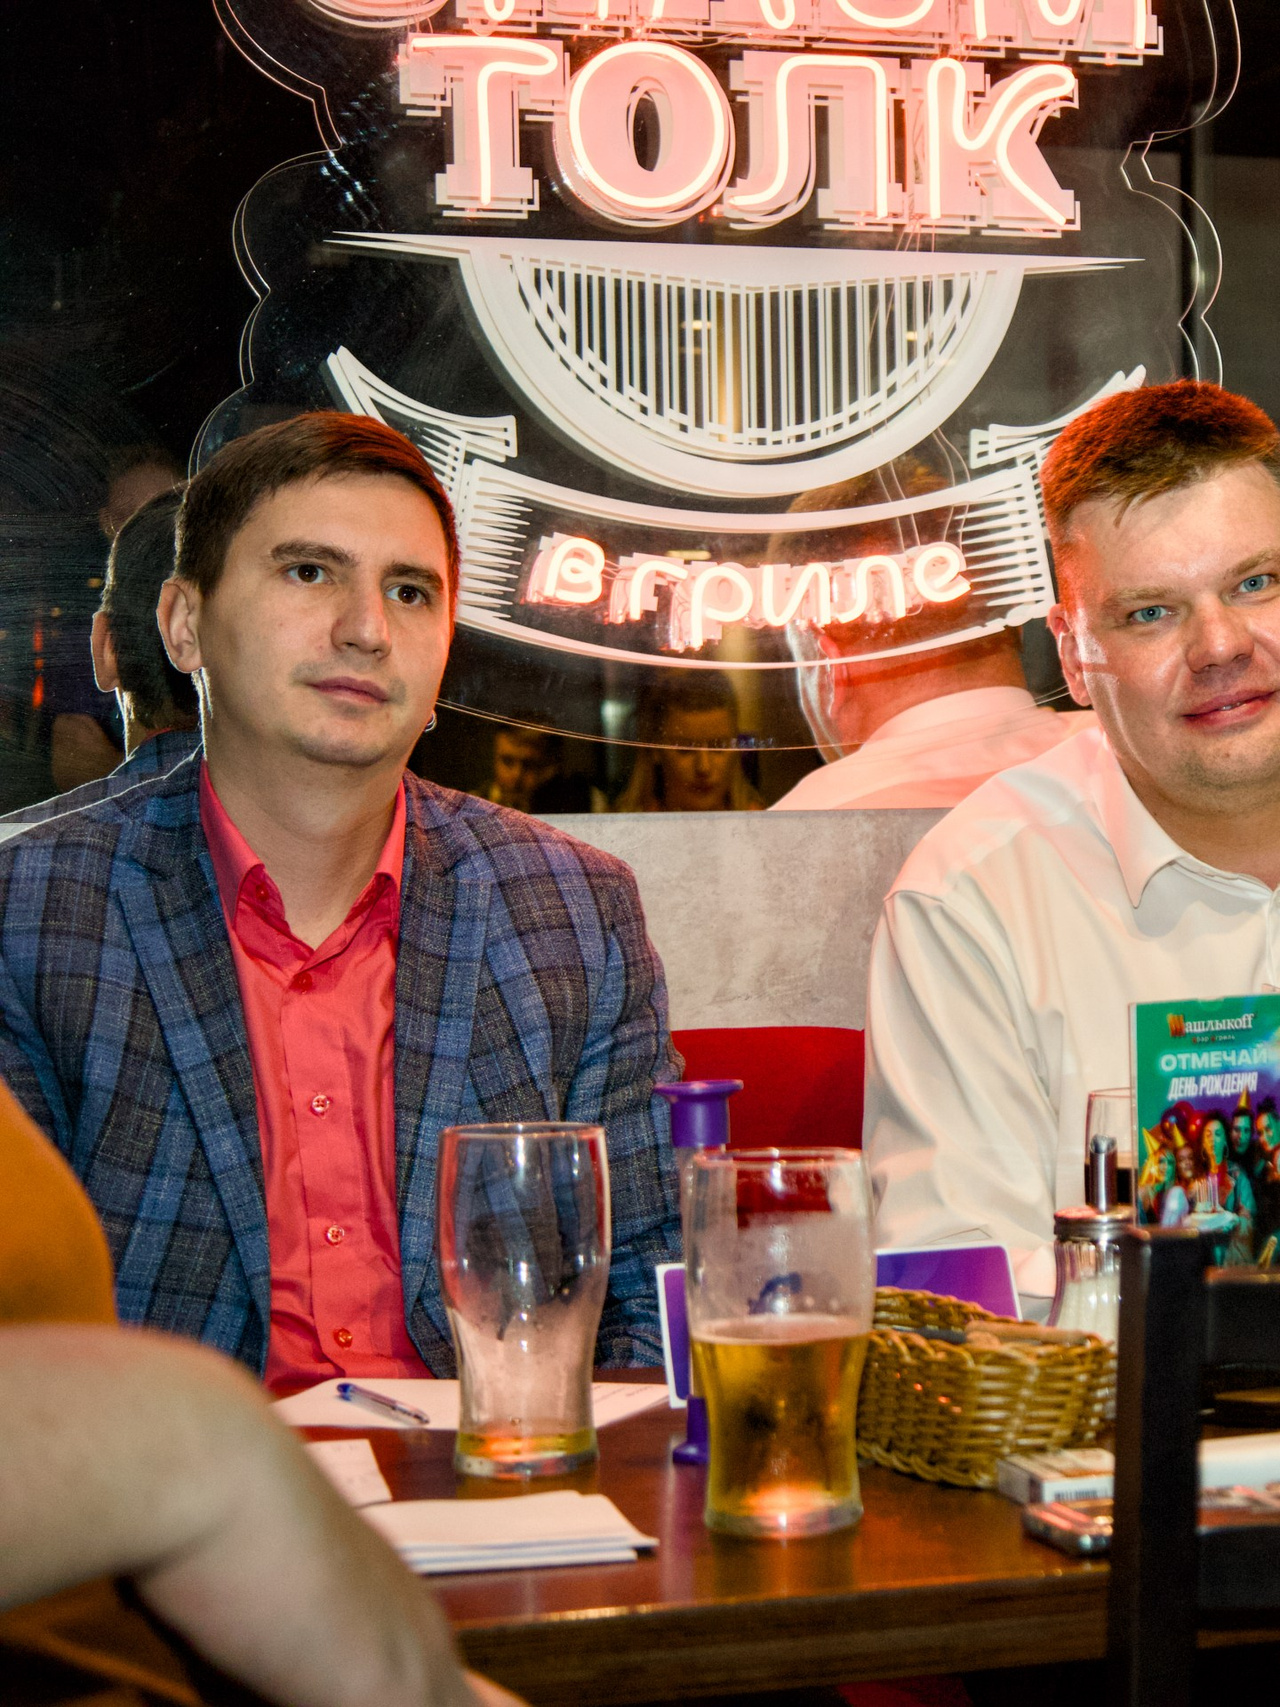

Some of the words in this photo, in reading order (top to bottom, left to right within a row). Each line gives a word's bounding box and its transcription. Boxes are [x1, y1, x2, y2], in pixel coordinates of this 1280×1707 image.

[398, 33, 1080, 231] ТОЛК
[605, 541, 972, 652] гриле
[1160, 1042, 1269, 1072] ОТМЕЧАЙ
[1168, 1076, 1199, 1101] ДЕНЬ
[1199, 1072, 1258, 1097] РОЖДЕНИЯ
